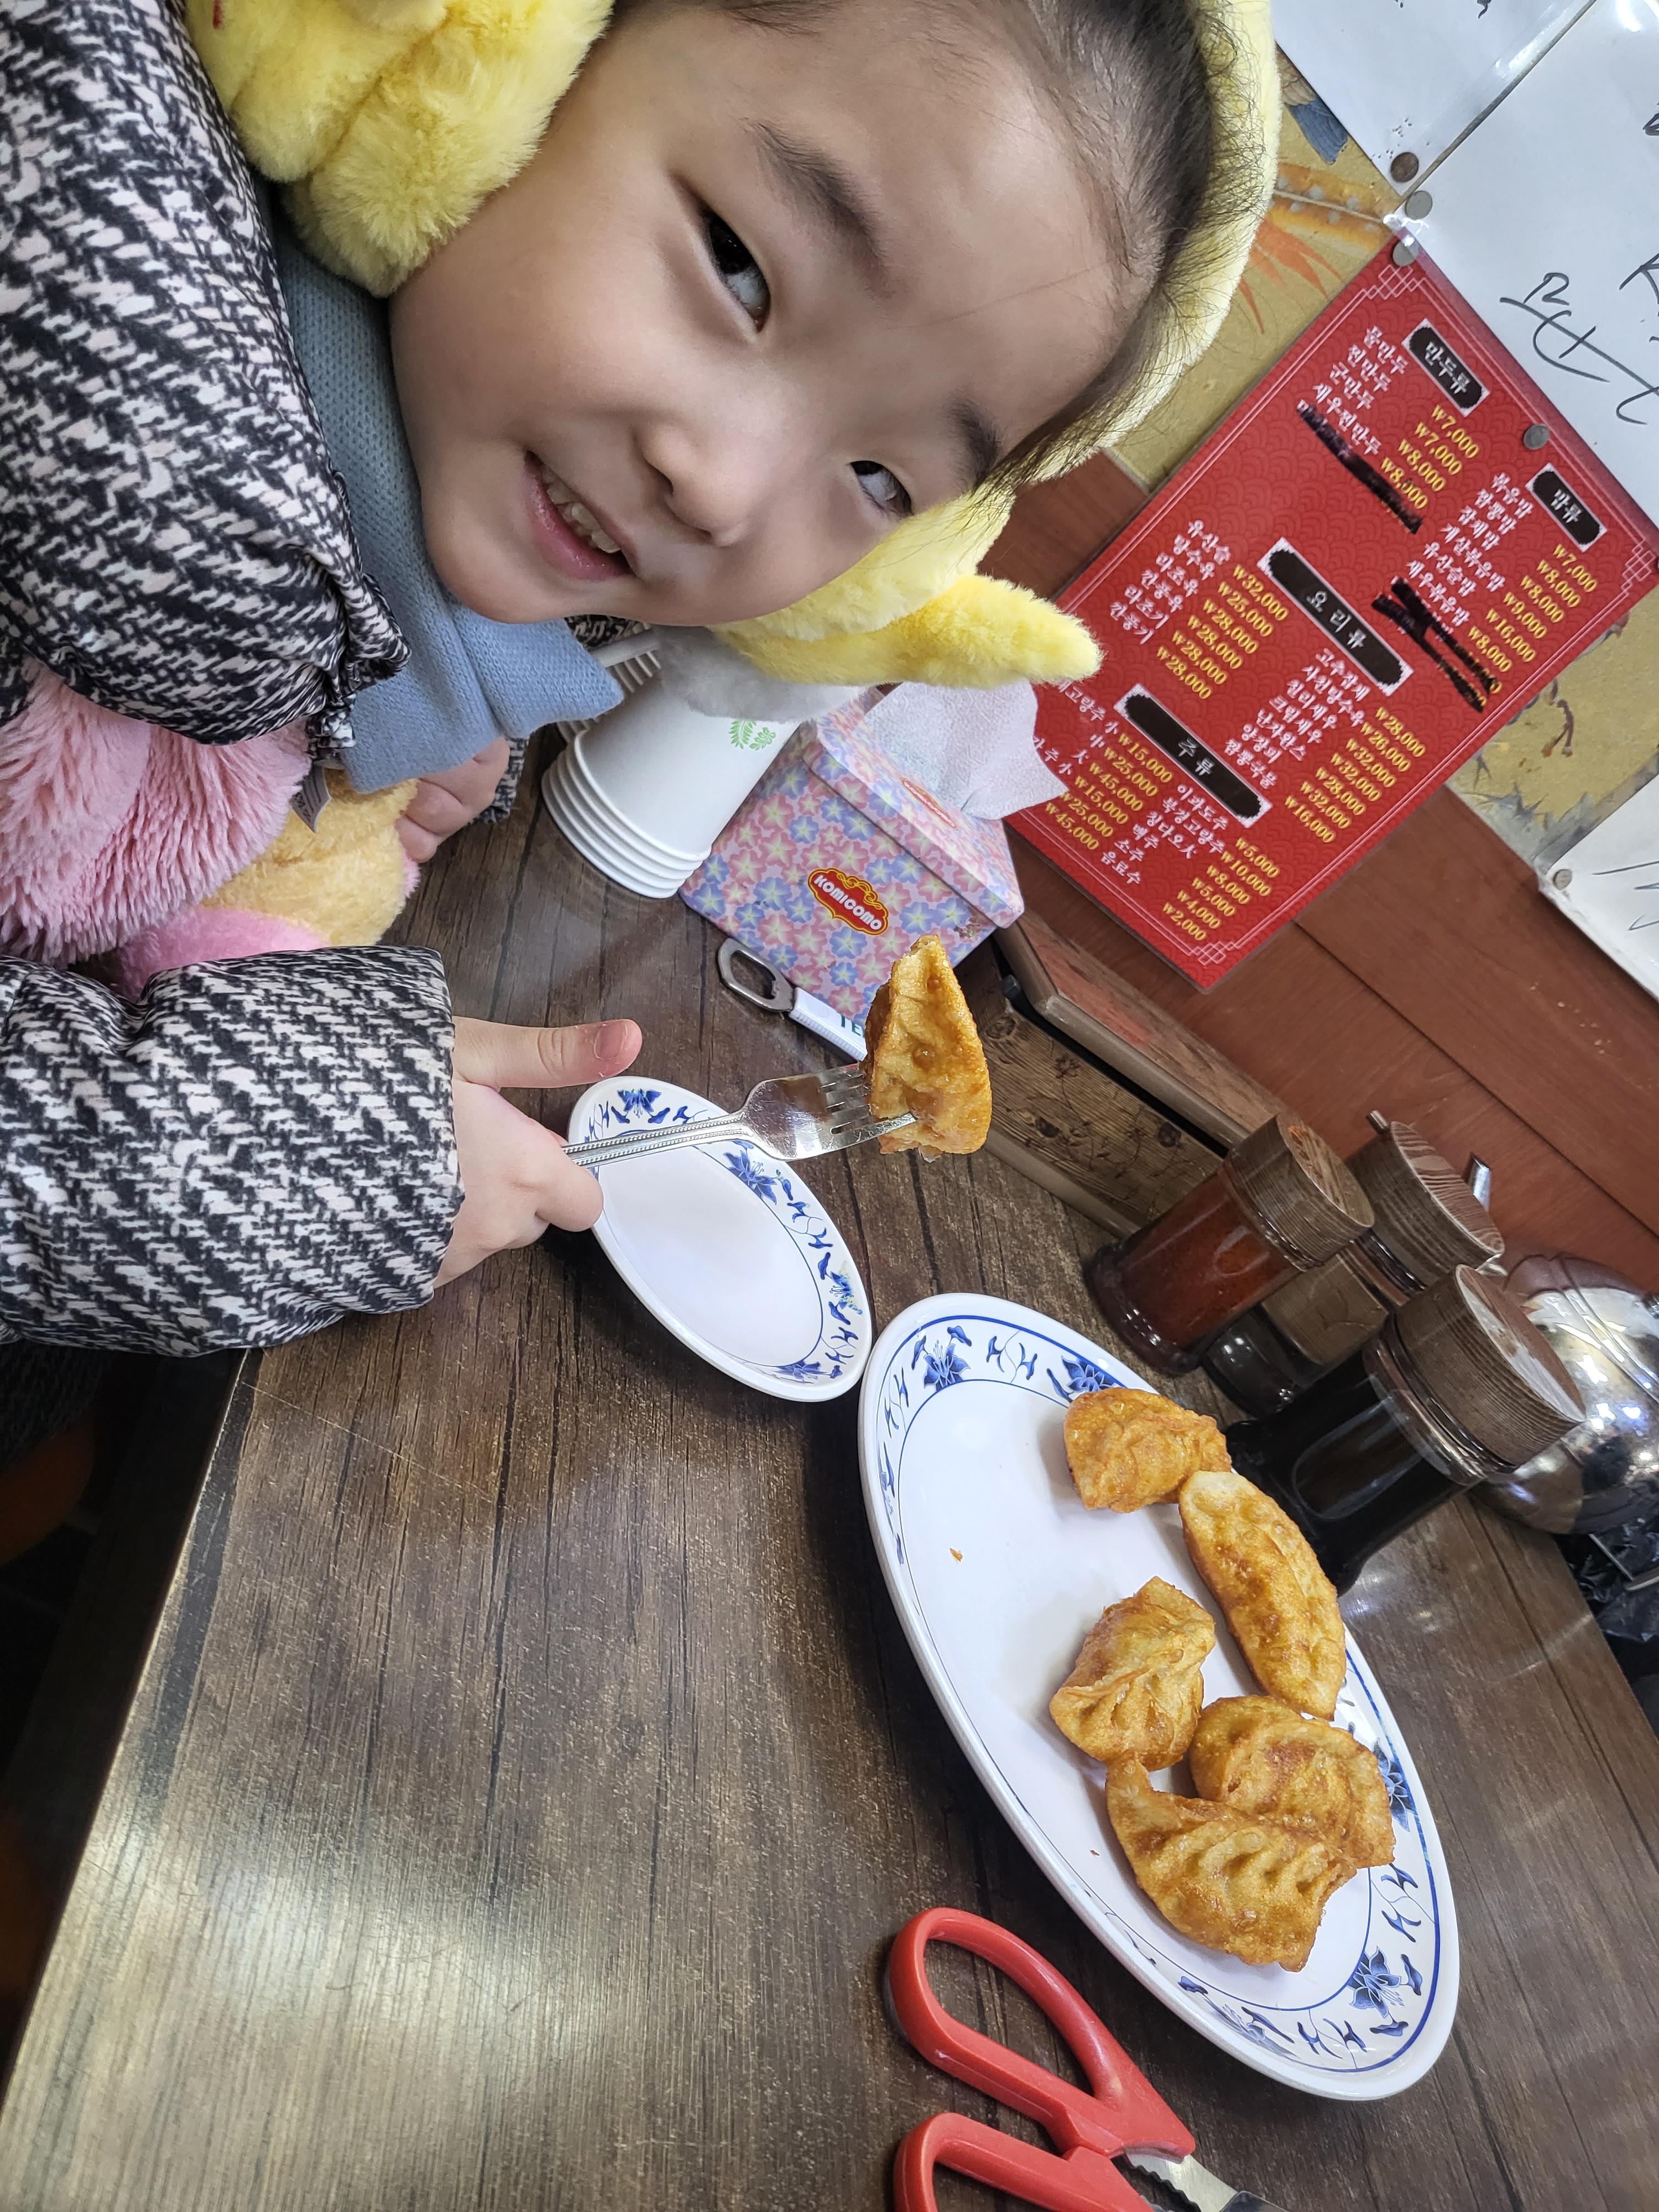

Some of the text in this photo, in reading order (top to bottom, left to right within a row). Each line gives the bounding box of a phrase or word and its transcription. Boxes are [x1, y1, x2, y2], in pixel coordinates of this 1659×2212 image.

[1329, 362, 1375, 410] 군만두
[1347, 344, 1391, 392] 찐만두
[1425, 342, 1470, 394] 만두류
[1312, 383, 1382, 455] 새우찐만두
[1474, 488, 1517, 535] 짬뽕밥
[1491, 472, 1533, 519] 볶음밥
[1551, 489, 1582, 523] 밥류
[1458, 505, 1500, 551] 잡채밥
[1155, 552, 1199, 598] 라조육
[1173, 534, 1215, 581] 탕수육
[1422, 541, 1477, 597] 유산슬밥
[1124, 586, 1170, 629] 라조기
[1406, 560, 1470, 627] 새우볶음밥
[1302, 665, 1365, 727] 사천탕수육
[1315, 648, 1369, 702] 고추잡채
[1058, 680, 1106, 721] 고량주
[1269, 696, 1322, 744] 크림새우
[1287, 680, 1337, 729] 칠리새우
[1241, 724, 1282, 764] 양장피
[1256, 709, 1306, 761] 난자완스
[1224, 738, 1277, 789] 짬뽕국물
[1162, 797, 1225, 853] 북경고량주
[1177, 784, 1228, 830] 이과도주
[1114, 839, 1144, 862] 소주
[1133, 823, 1159, 849] 맥주
[1101, 851, 1140, 884] 음료수
[814, 875, 882, 930] KOMICOMO
[841, 1014, 865, 1038] TE
